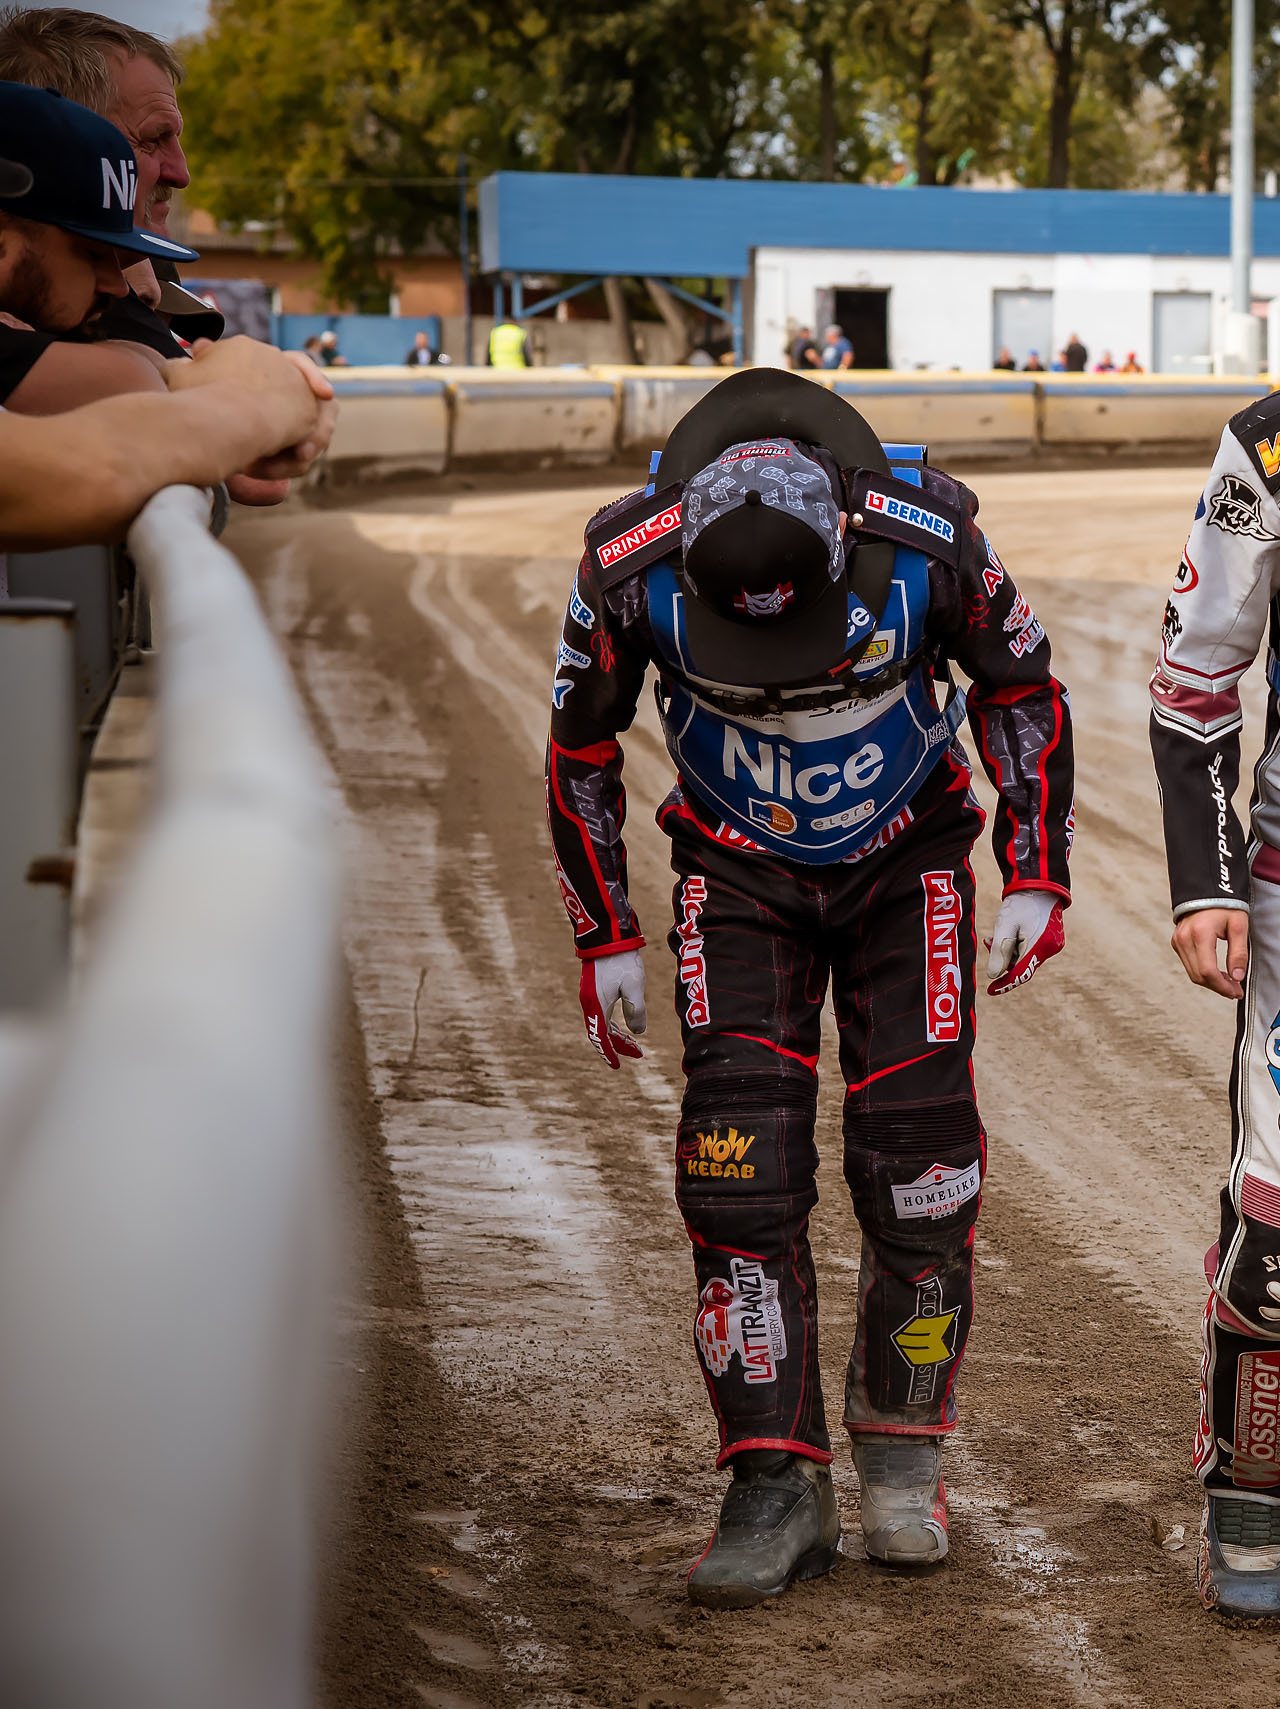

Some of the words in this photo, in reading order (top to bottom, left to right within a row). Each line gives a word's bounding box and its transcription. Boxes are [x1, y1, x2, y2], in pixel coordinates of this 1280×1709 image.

[101, 157, 138, 210] Ni
[887, 500, 953, 540] BERNER
[723, 724, 884, 804] Nice
[1207, 752, 1234, 894] kw-products
[929, 877, 961, 1036] PRINTSOL
[994, 954, 1040, 995] THOR
[687, 1160, 755, 1179] KEBAB
[903, 1175, 977, 1207] HOMELIKE
[926, 1199, 962, 1215] HOTEL
[735, 1262, 773, 1380] LATTRANZIT
[768, 1318, 783, 1357] DELIVERY
[915, 1365, 932, 1401] STYLE
[1238, 1381, 1253, 1429] PERFORMANCE
[1217, 1357, 1280, 1482] Wossner
